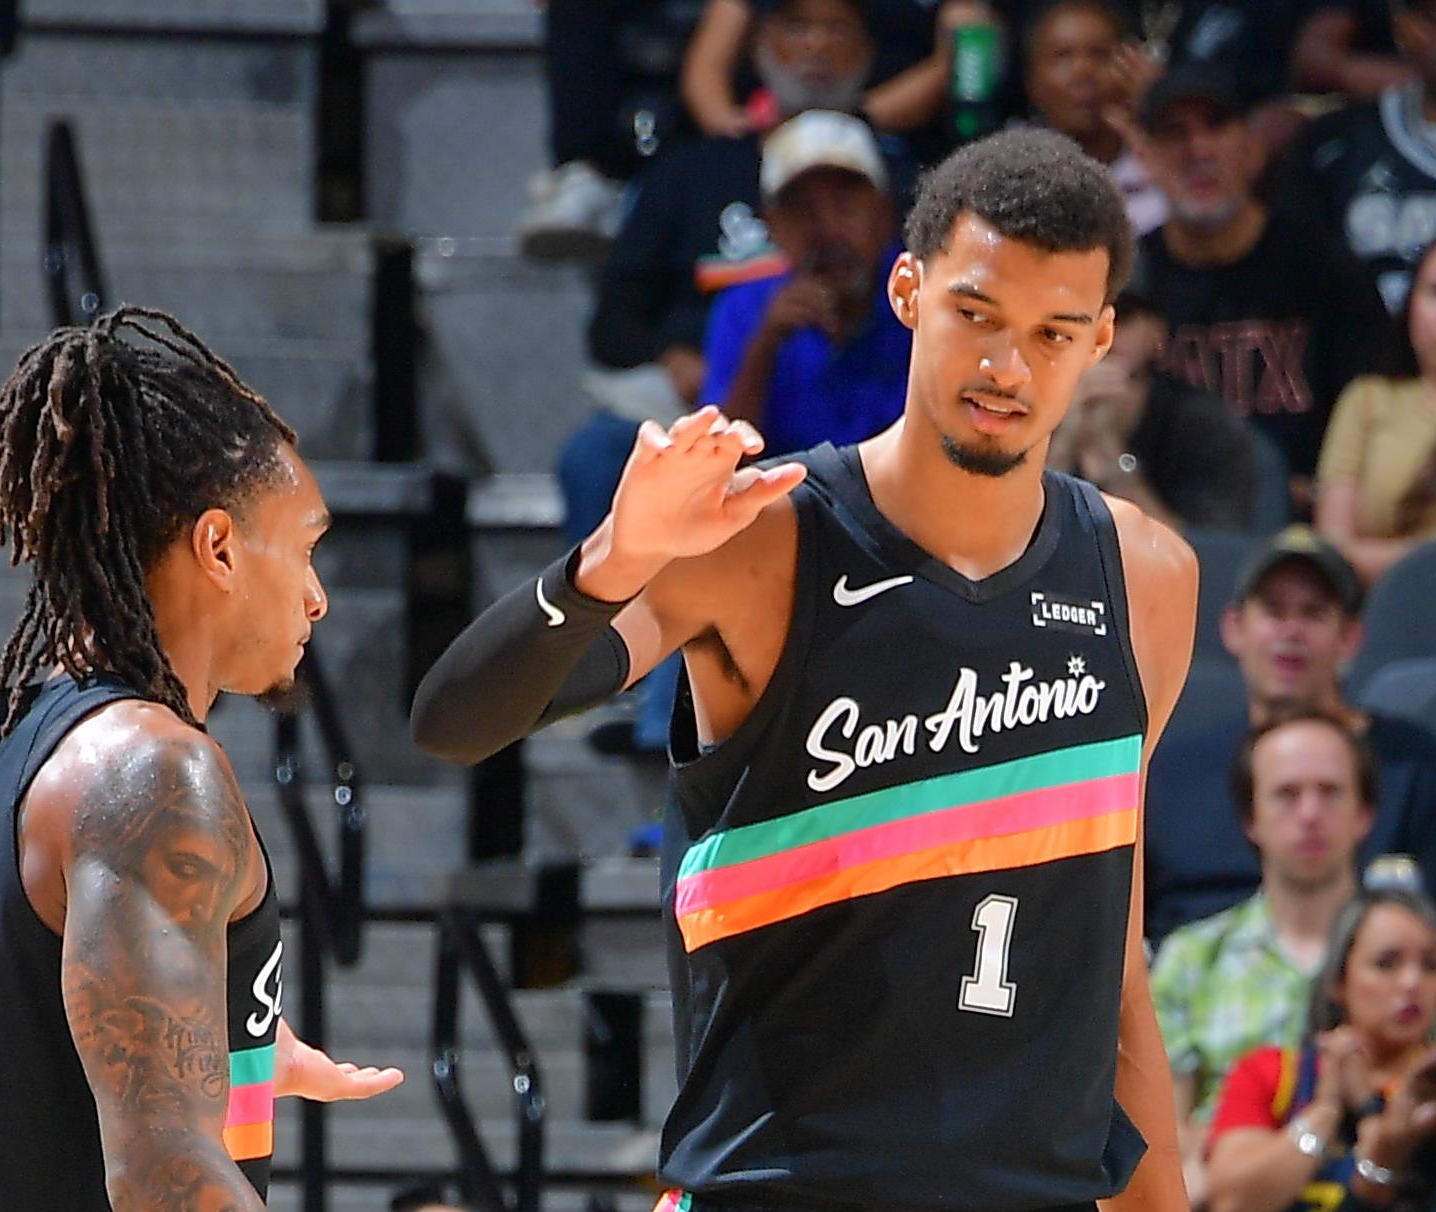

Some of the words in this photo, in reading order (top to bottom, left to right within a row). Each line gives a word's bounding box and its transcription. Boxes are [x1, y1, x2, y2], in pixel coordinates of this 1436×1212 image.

[1041, 601, 1097, 627] LEDGER
[806, 696, 917, 793] San
[925, 655, 1105, 753] Antonio
[957, 893, 1018, 1017] 1
